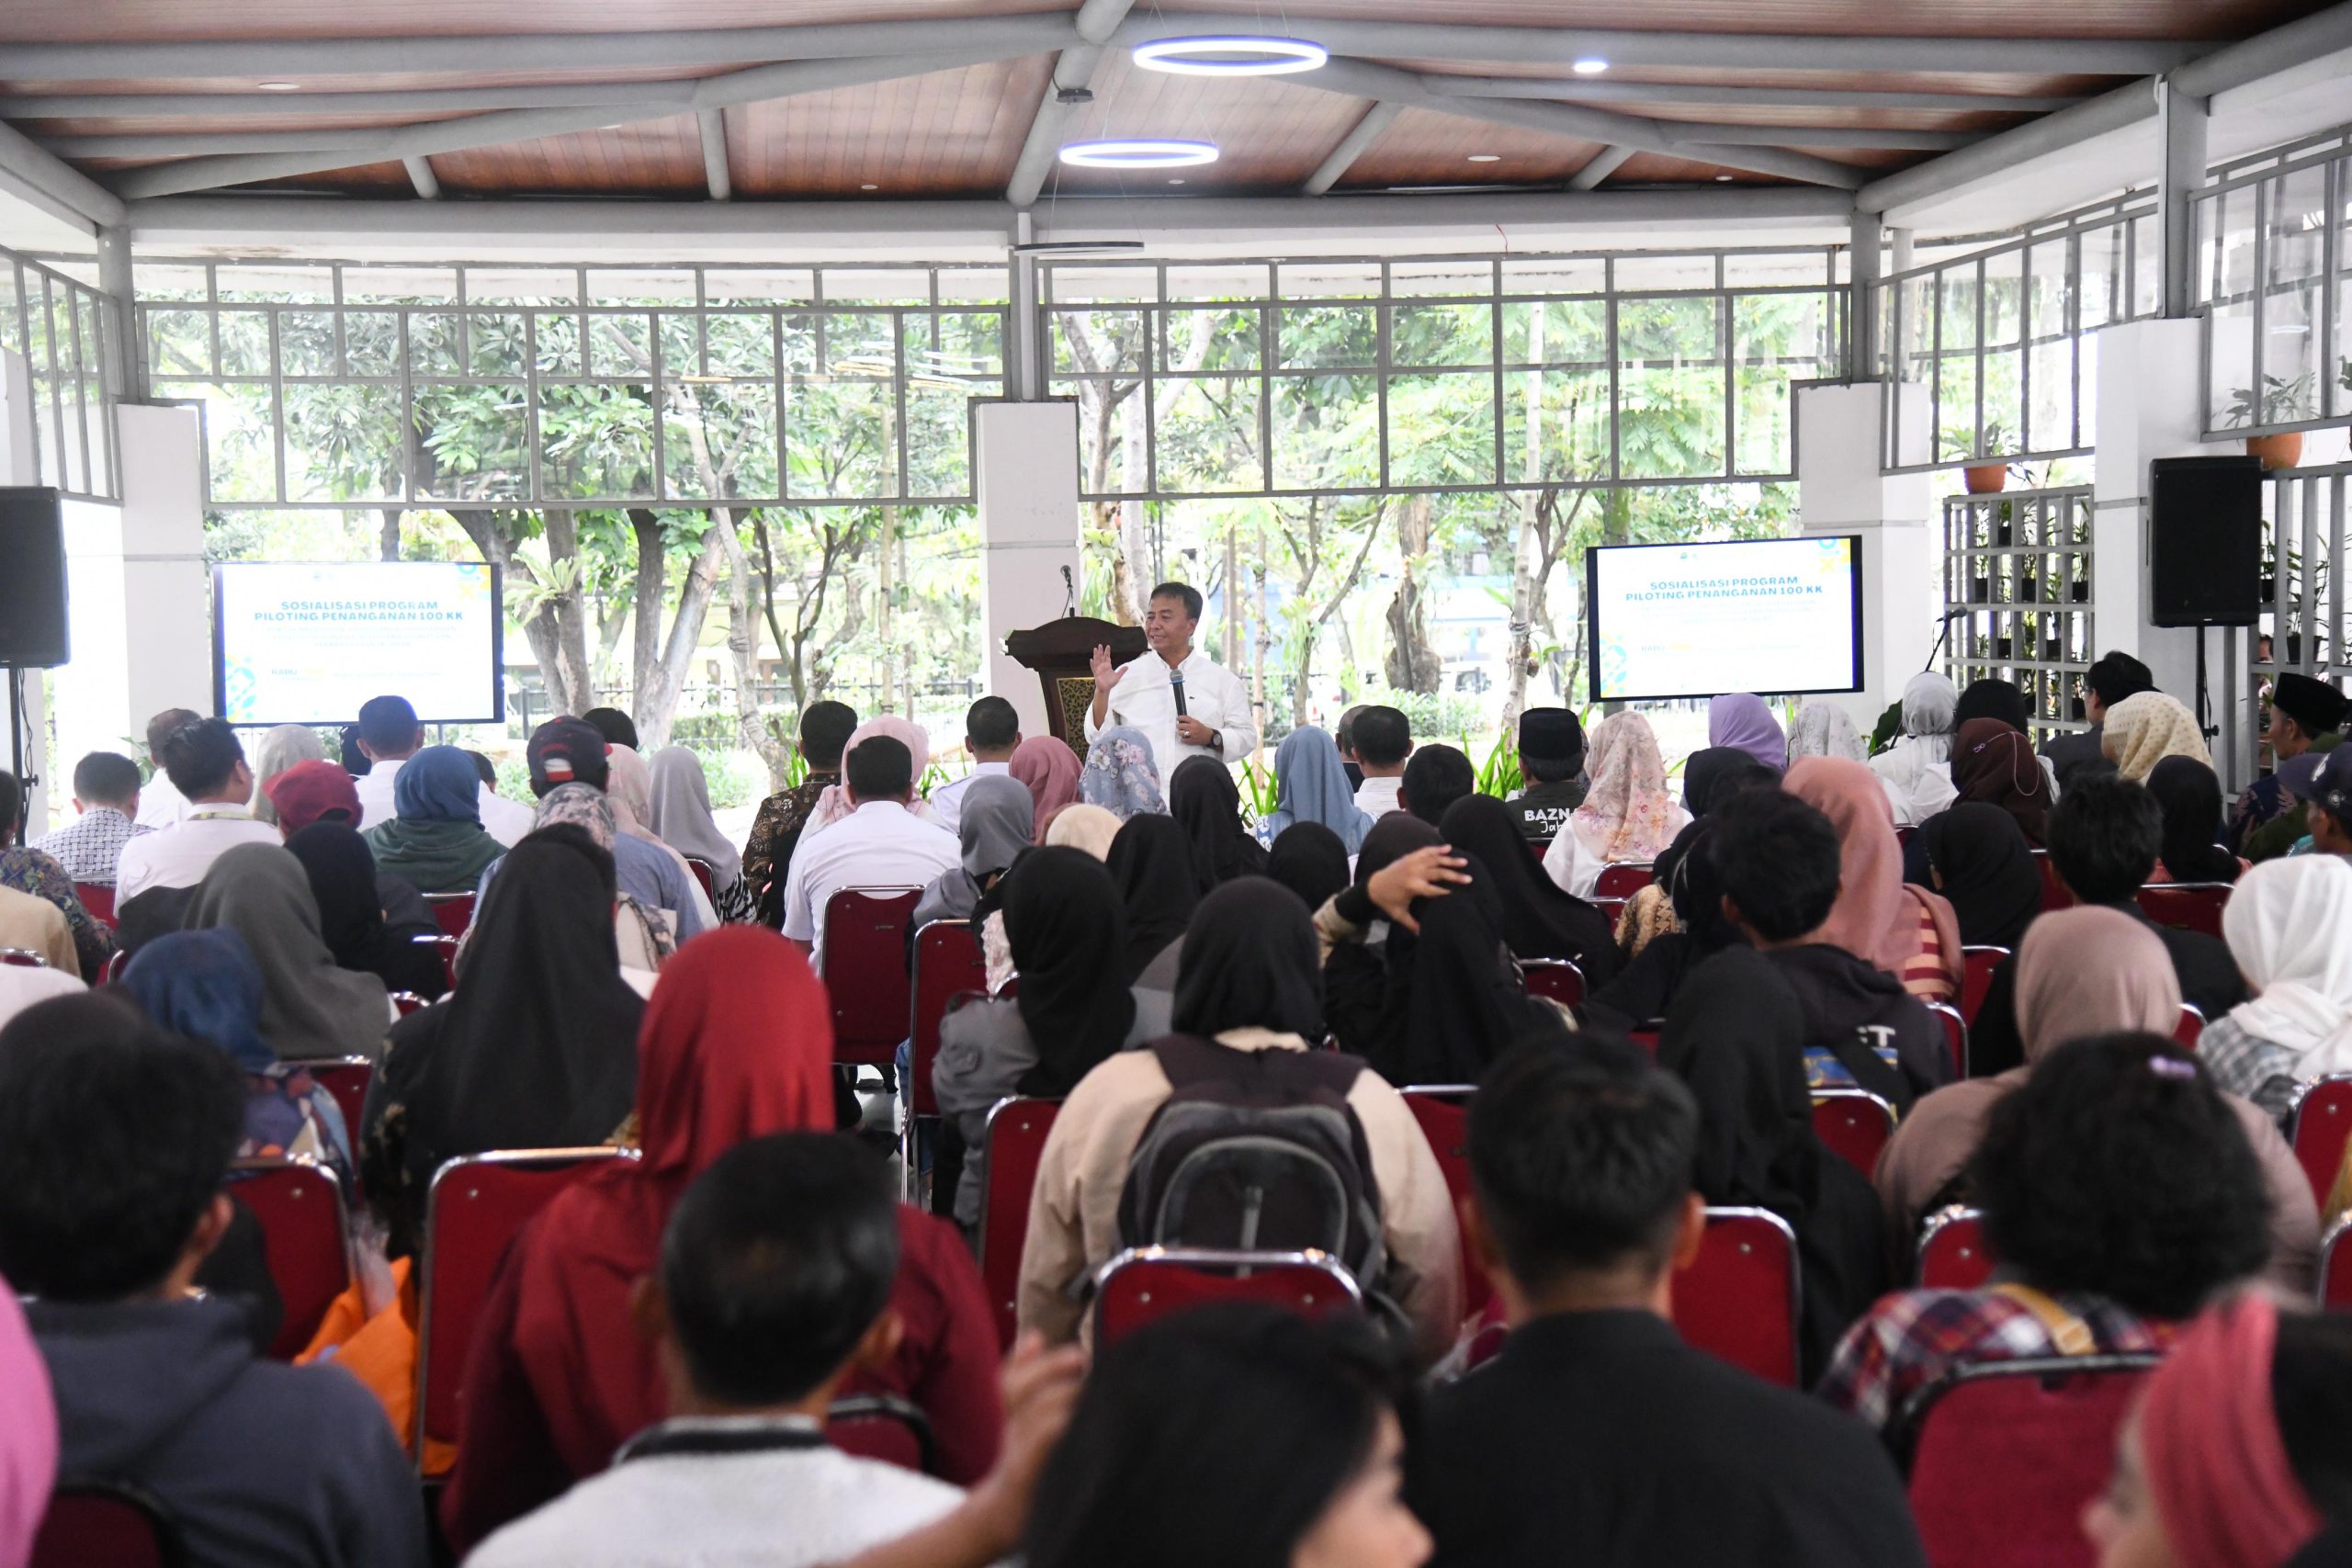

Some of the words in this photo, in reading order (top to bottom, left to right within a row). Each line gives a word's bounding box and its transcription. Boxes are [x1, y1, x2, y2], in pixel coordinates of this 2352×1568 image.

[1650, 580, 1729, 590] SOSIALISASI
[1732, 576, 1798, 586] PROGRAM
[1626, 591, 1685, 601] PILOTING
[1688, 588, 1778, 598] PENANGANAN
[1781, 586, 1803, 595] 100
[1806, 585, 1823, 593] KK
[281, 602, 366, 610] SOSIALISASI
[369, 602, 438, 610] PROGRAM
[254, 612, 319, 621] PILOTING
[322, 612, 416, 621] PENANGANAN
[420, 612, 443, 620] 100
[447, 612, 463, 620] KK
[1524, 808, 1571, 821] BAZN
